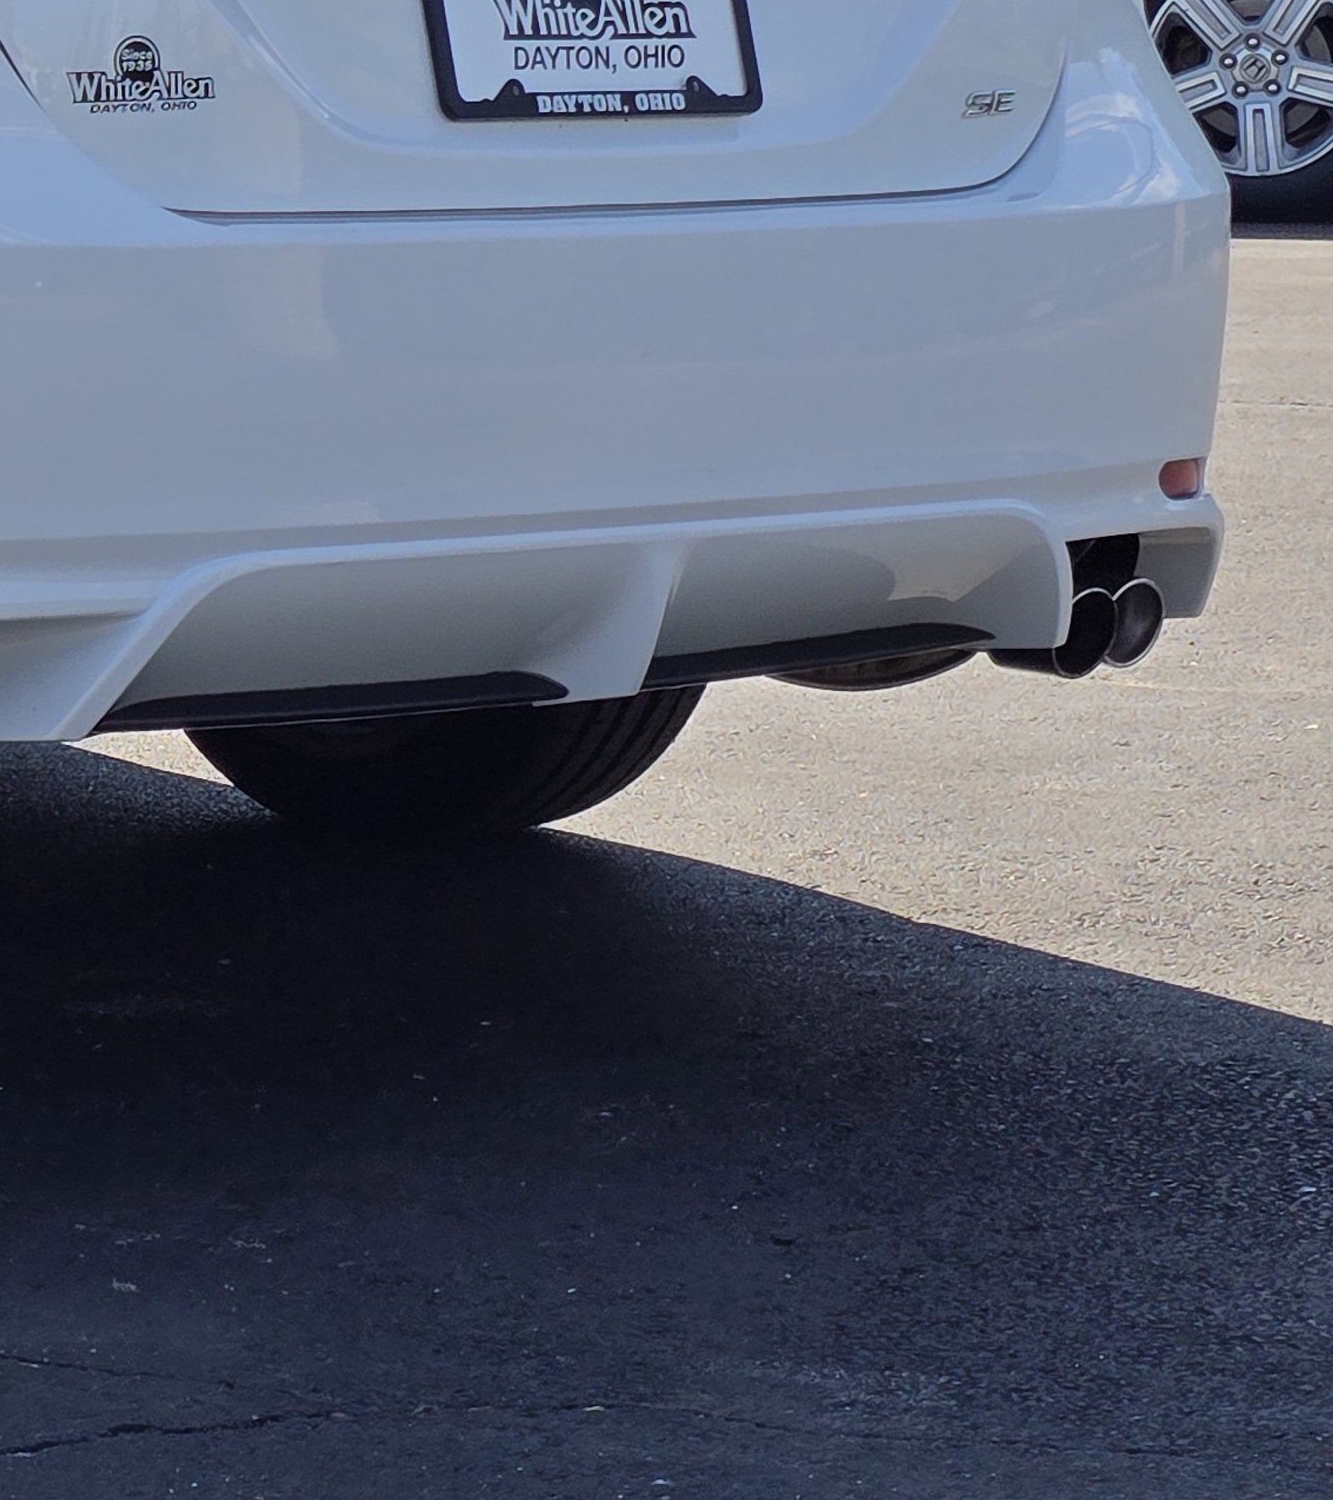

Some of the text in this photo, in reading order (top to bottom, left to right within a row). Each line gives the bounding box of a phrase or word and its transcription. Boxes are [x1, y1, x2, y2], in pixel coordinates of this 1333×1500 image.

[513, 44, 685, 74] DAYTON, OHIO
[89, 101, 198, 114] DAYTON, OHIO
[536, 93, 686, 114] DAYTON, OHIO
[962, 90, 1016, 119] SE
